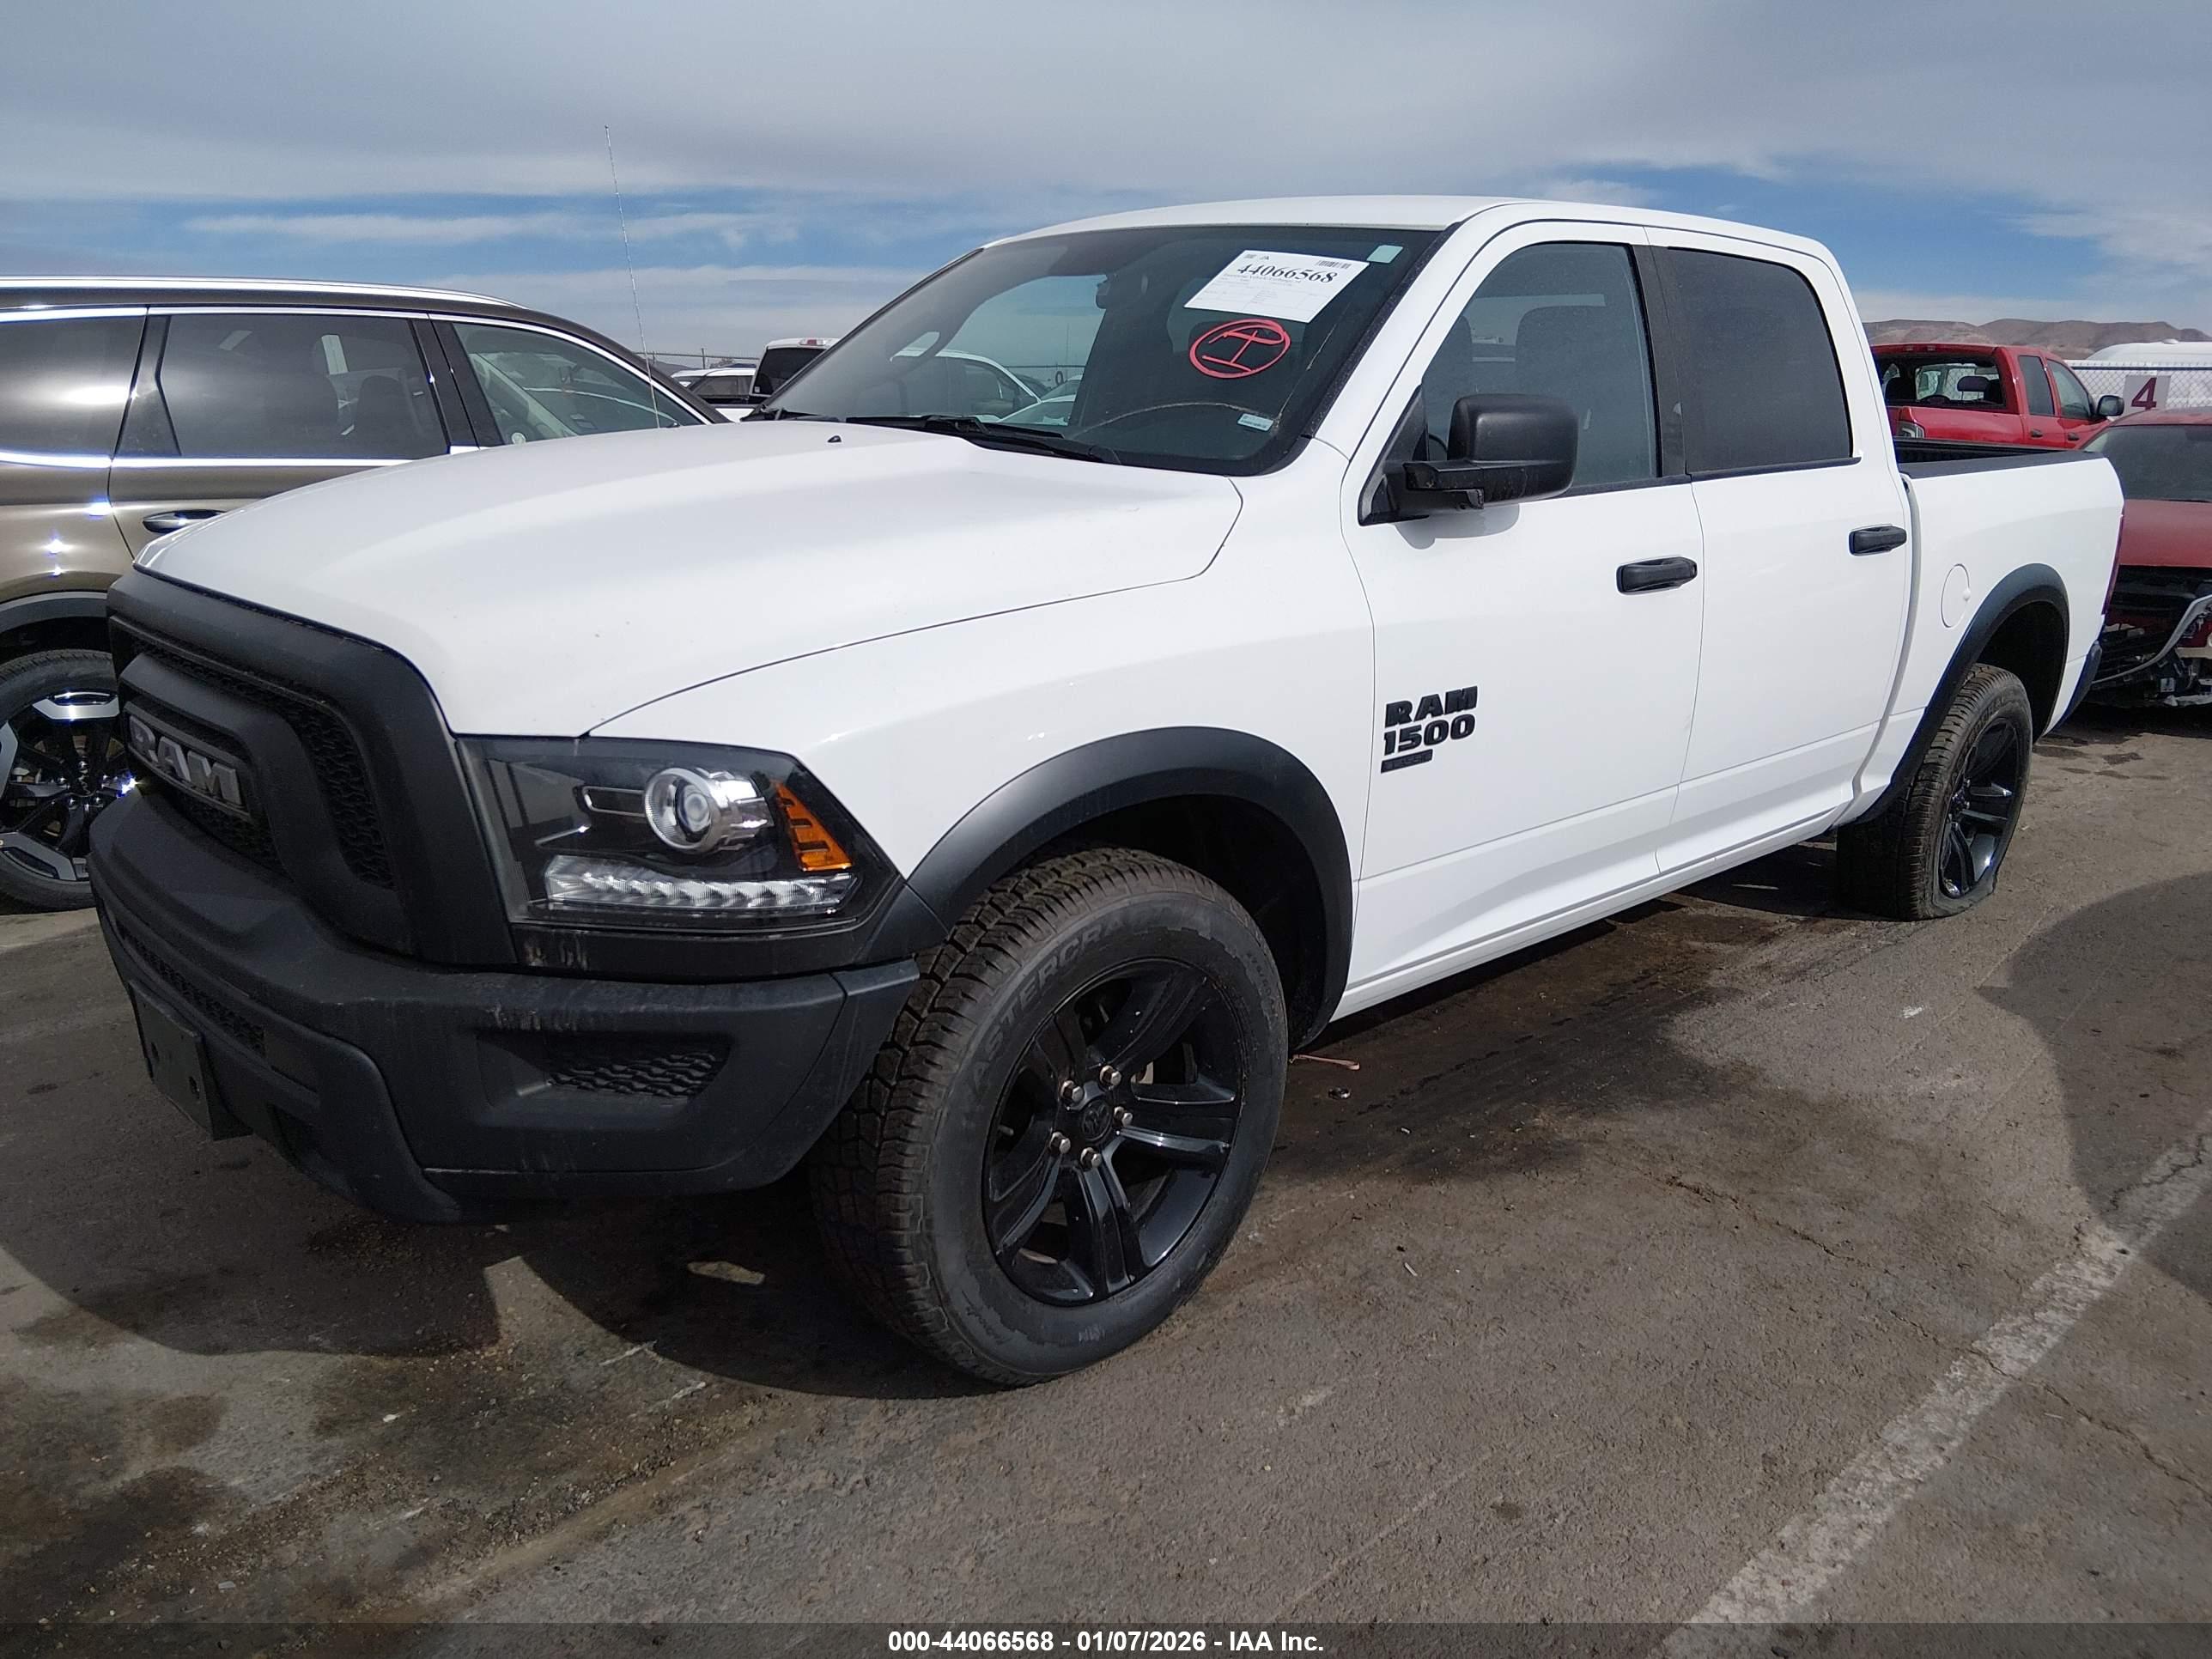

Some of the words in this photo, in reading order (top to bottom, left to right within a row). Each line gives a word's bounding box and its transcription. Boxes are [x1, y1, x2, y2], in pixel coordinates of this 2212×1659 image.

[1237, 263, 1338, 283] 44066568
[2130, 376, 2158, 410] 4
[1384, 685, 1479, 728] RAM
[1383, 714, 1476, 757] 1500
[129, 714, 242, 805] RAM
